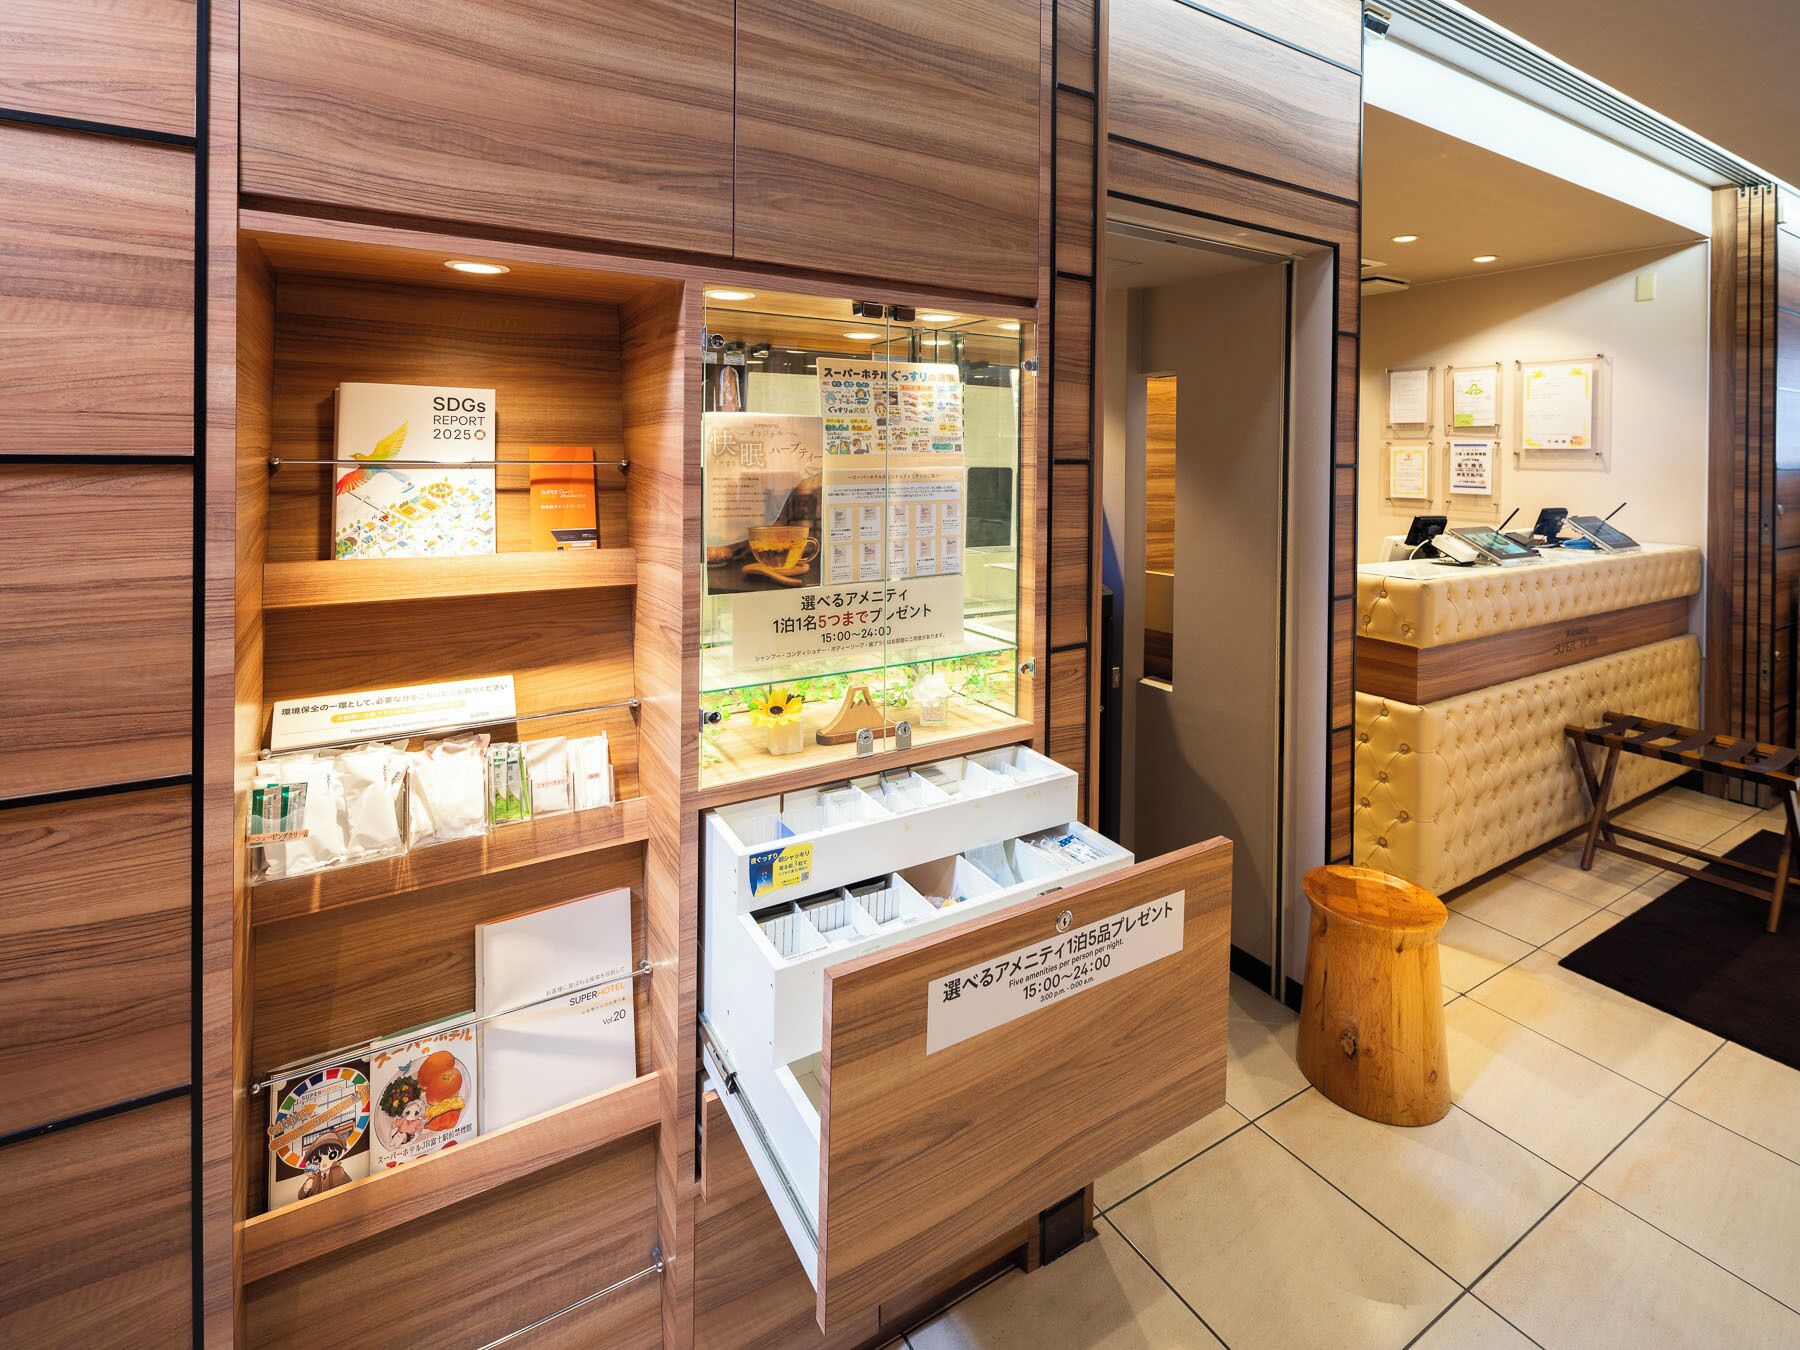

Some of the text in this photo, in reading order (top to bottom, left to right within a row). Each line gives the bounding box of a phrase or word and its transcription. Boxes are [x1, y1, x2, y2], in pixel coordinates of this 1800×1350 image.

[433, 396, 486, 412] SDGs
[433, 415, 486, 426] REPORT
[433, 428, 471, 440] 2025
[801, 588, 908, 612] 選べるアメニティ
[942, 901, 1173, 1003] 選べるアメニティ1泊5品プレゼント
[1009, 939, 1124, 989] Five amenities per person per night.
[569, 981, 625, 1007] SUPERHOTEL
